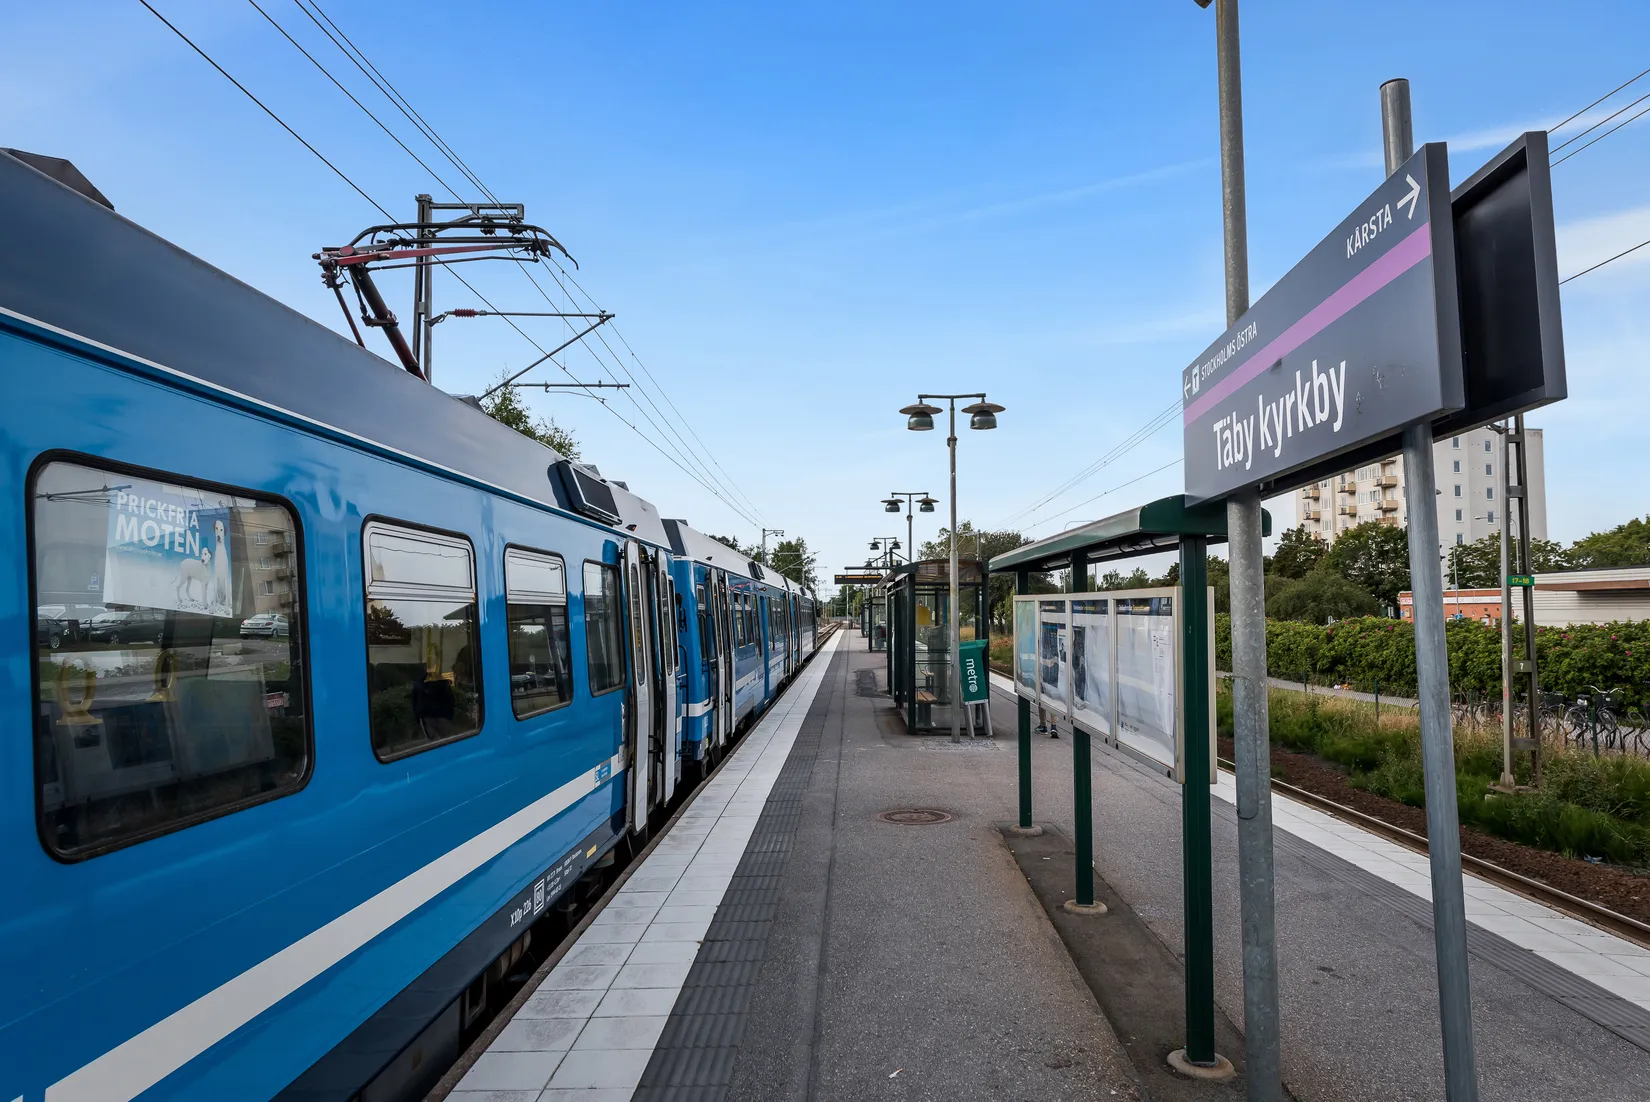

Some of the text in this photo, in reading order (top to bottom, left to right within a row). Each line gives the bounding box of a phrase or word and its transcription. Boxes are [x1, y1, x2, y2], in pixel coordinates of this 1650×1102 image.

[1346, 203, 1393, 259] KÅRSTA
[1201, 339, 1236, 381] STOCKHOLMS
[1236, 320, 1258, 351] ÖSTRA
[1213, 359, 1347, 471] Täby kyrkby
[116, 491, 200, 530] PRICKFRIA
[115, 513, 200, 557] MOTEN
[965, 658, 979, 693] metro
[1519, 662, 1525, 670] 7
